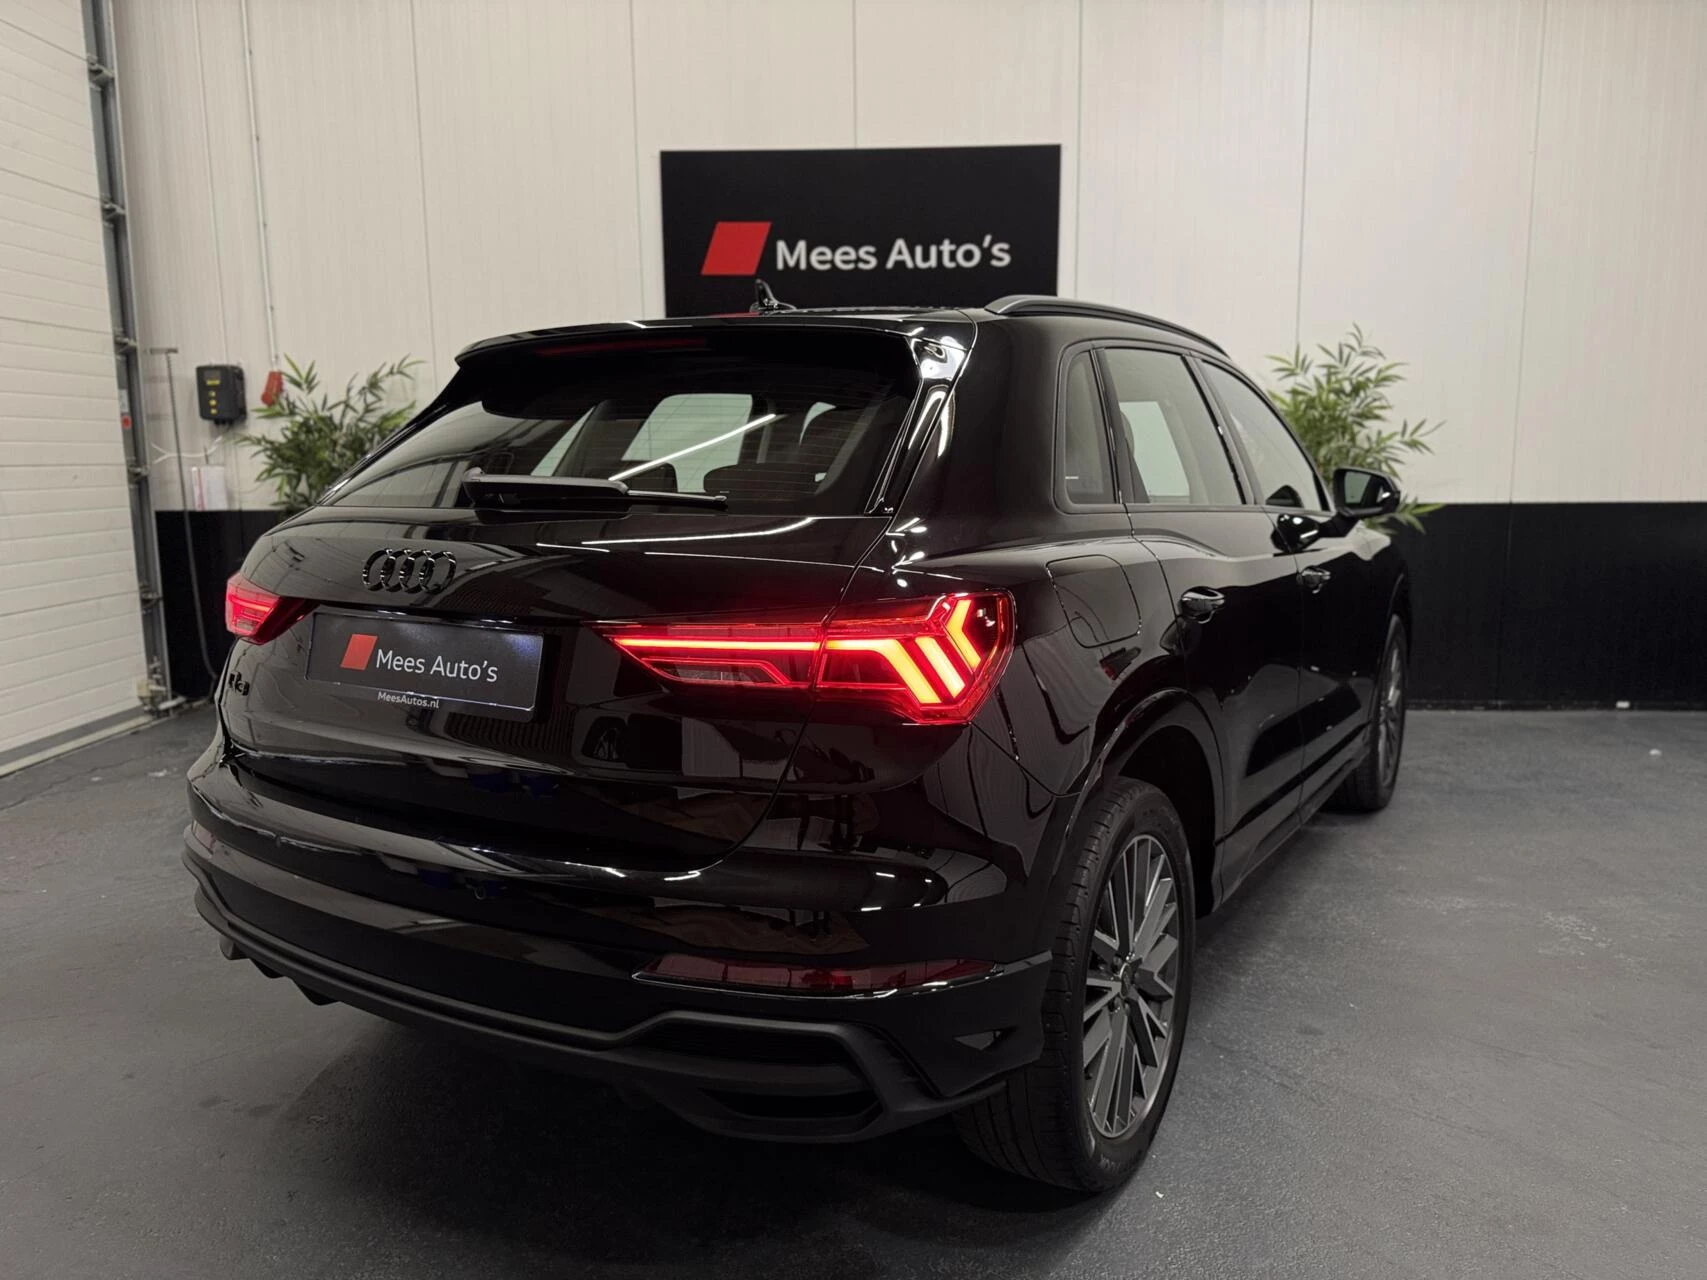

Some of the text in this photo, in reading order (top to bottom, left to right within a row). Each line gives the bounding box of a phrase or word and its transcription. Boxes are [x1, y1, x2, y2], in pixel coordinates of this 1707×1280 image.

[775, 234, 1012, 271] Mees Auto's
[376, 648, 498, 683] Mees Auto's
[377, 691, 440, 709] MeesAutos.nl
